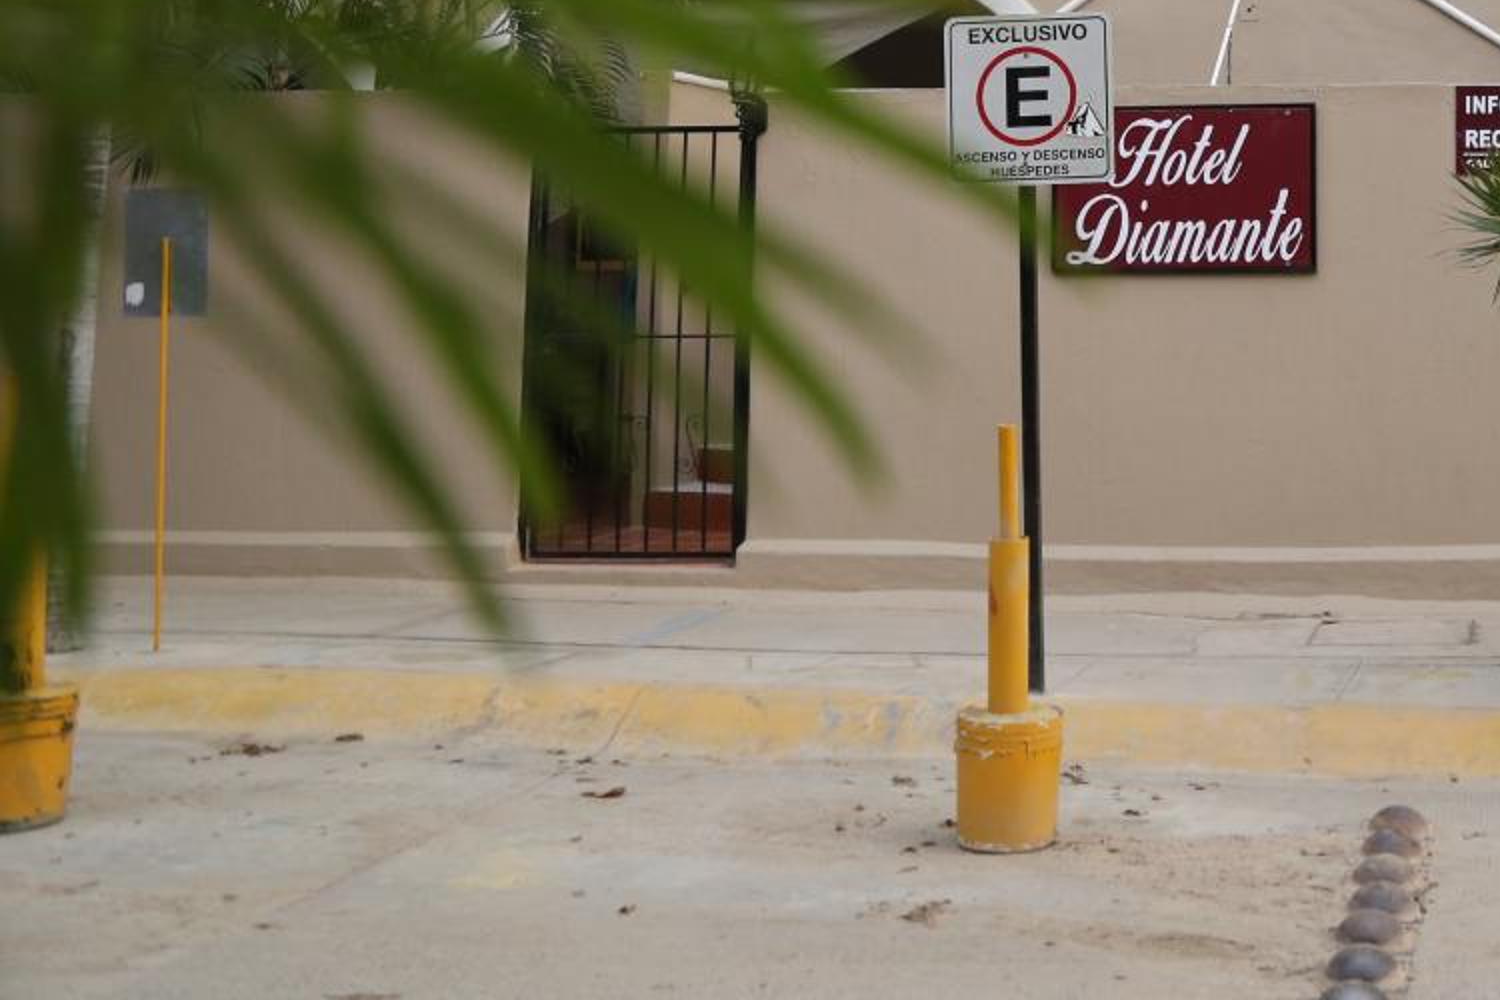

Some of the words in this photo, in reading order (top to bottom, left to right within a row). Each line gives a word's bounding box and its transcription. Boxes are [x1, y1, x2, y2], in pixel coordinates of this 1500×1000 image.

[968, 23, 1088, 45] EXCLUSIVO
[1005, 65, 1053, 129] E
[1021, 151, 1031, 162] Y
[1033, 147, 1105, 161] DESCENSO
[1109, 114, 1250, 187] Hotel
[1066, 188, 1303, 265] Diamante
